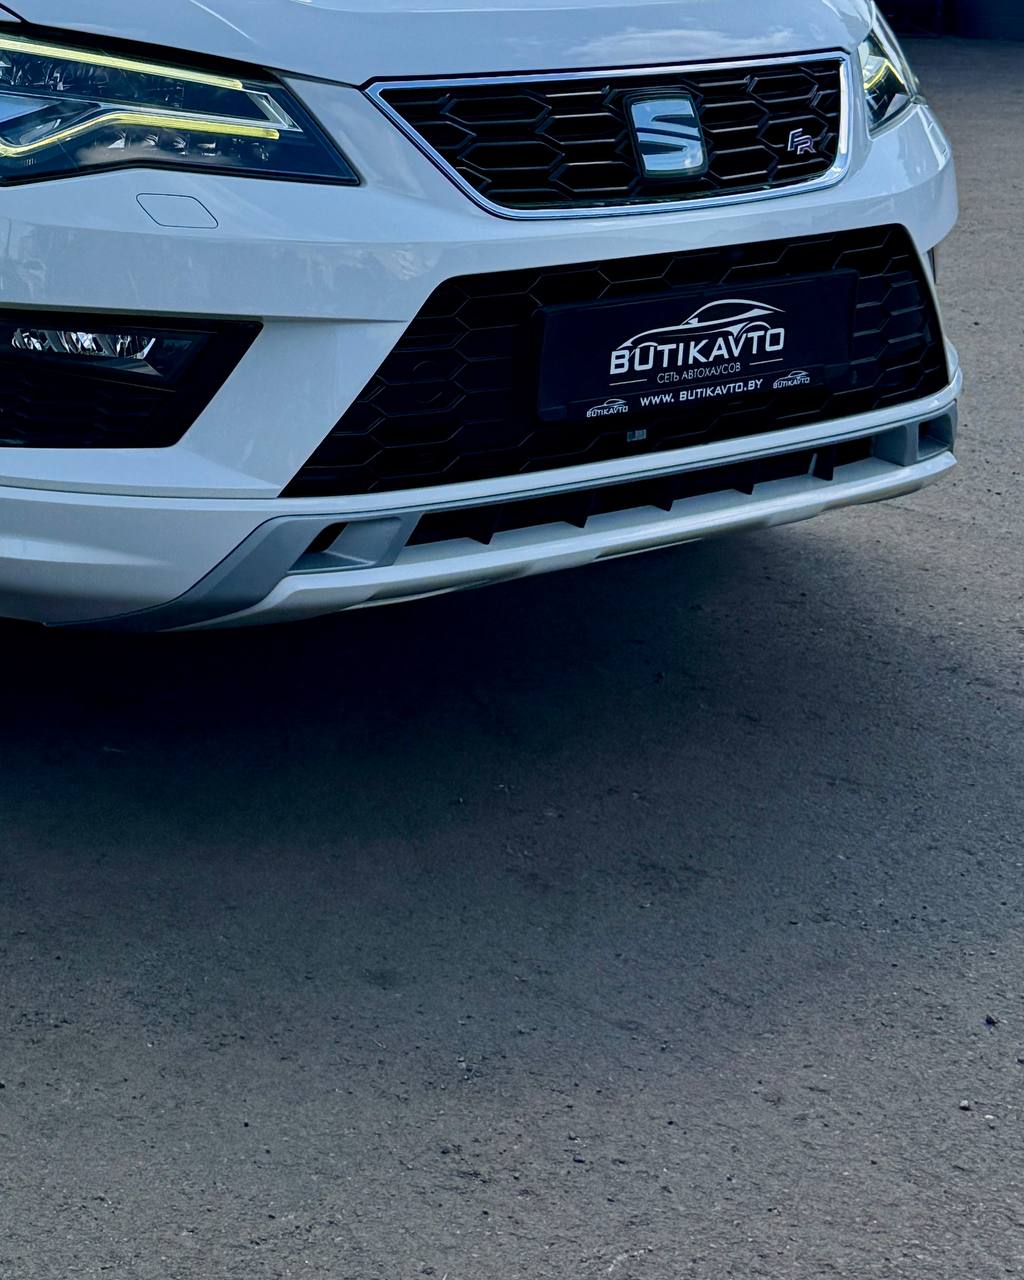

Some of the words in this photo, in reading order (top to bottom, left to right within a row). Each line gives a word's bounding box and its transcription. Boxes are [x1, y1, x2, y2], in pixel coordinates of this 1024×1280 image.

[787, 128, 817, 155] FR
[609, 327, 785, 375] BUTIKAVTO
[656, 372, 680, 383] СЕТЬ
[681, 362, 741, 381] АВТОХАУСОВ
[773, 377, 810, 389] BUTIKAVTO
[586, 406, 629, 418] BUTIKAVTO
